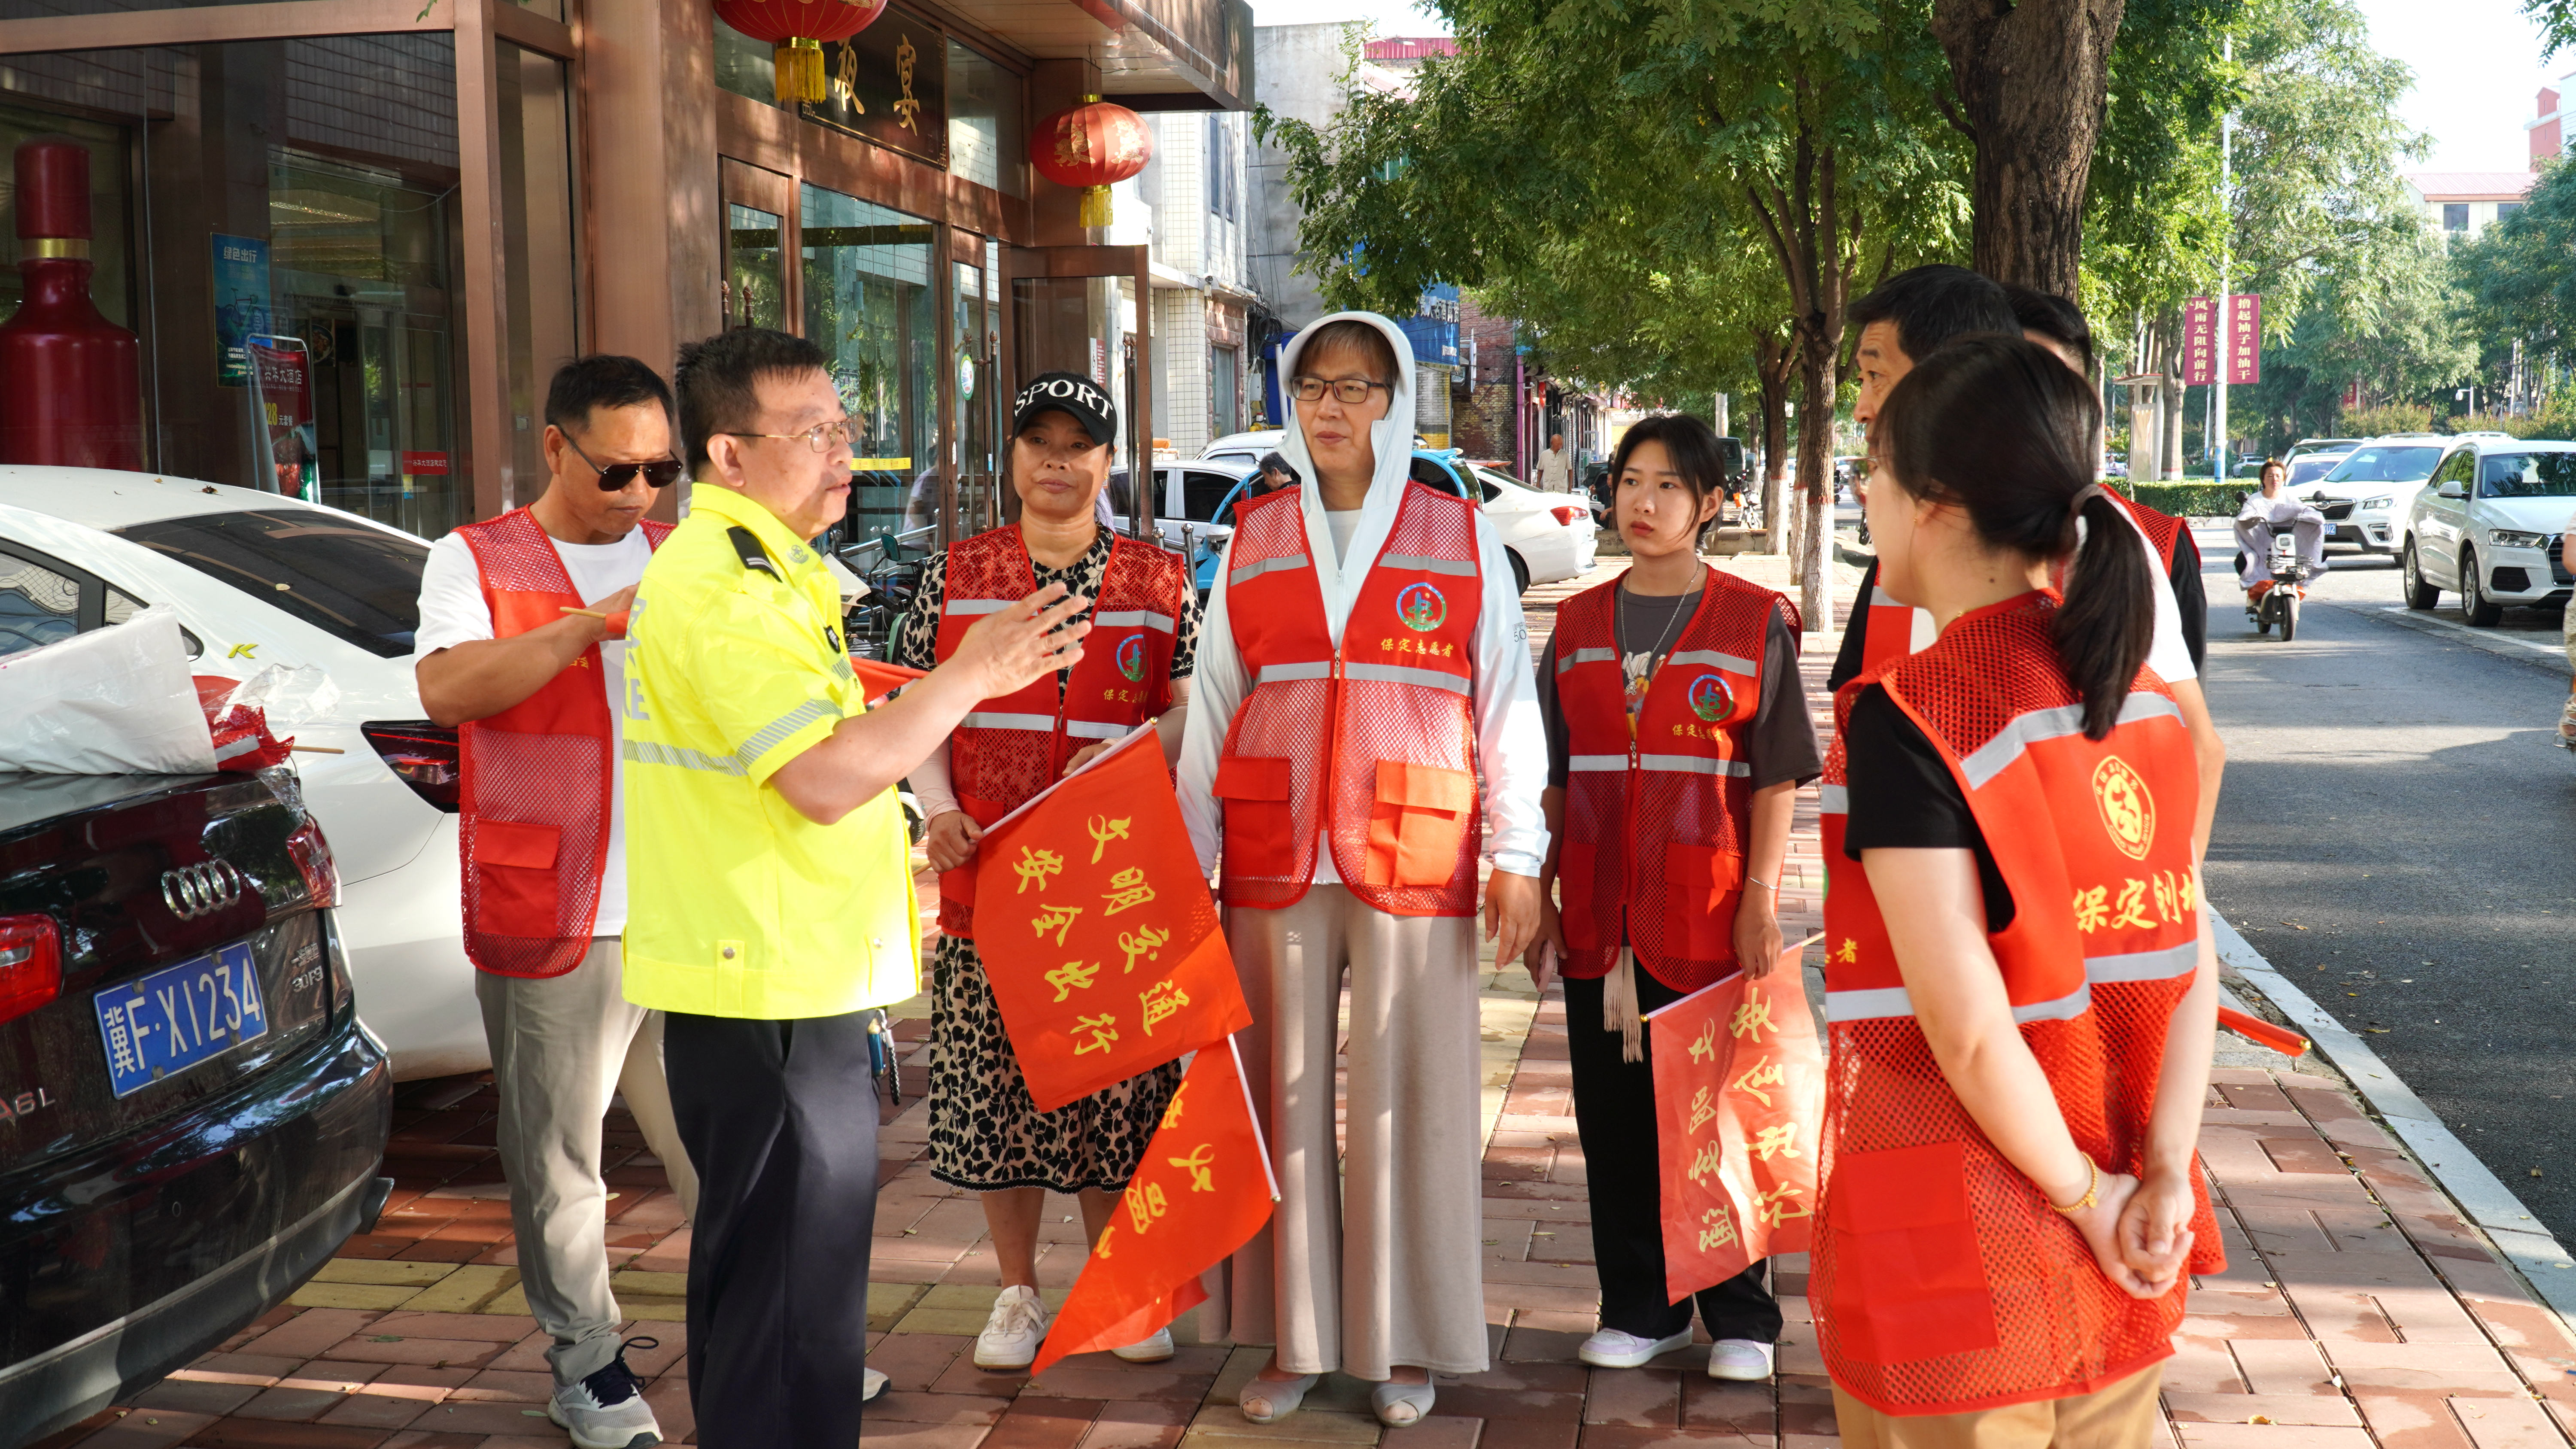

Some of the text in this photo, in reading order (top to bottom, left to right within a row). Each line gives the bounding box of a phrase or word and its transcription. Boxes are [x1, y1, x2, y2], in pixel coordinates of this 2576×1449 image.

[224, 246, 257, 263] 绿色出行
[2194, 300, 2208, 382] 风雨无阻向前行
[2237, 298, 2251, 380] 撸起袖子加油干
[264, 365, 302, 384] 兴华大酒店
[1015, 380, 1113, 420] SPORT
[279, 415, 292, 426] 元套餐
[1381, 638, 1454, 658] 保定志愿者
[1672, 724, 1722, 742] 保定志愿者
[1088, 814, 1190, 1037] 文明交通
[1013, 845, 1120, 1056] 安全出行
[1825, 938, 1858, 964] 者
